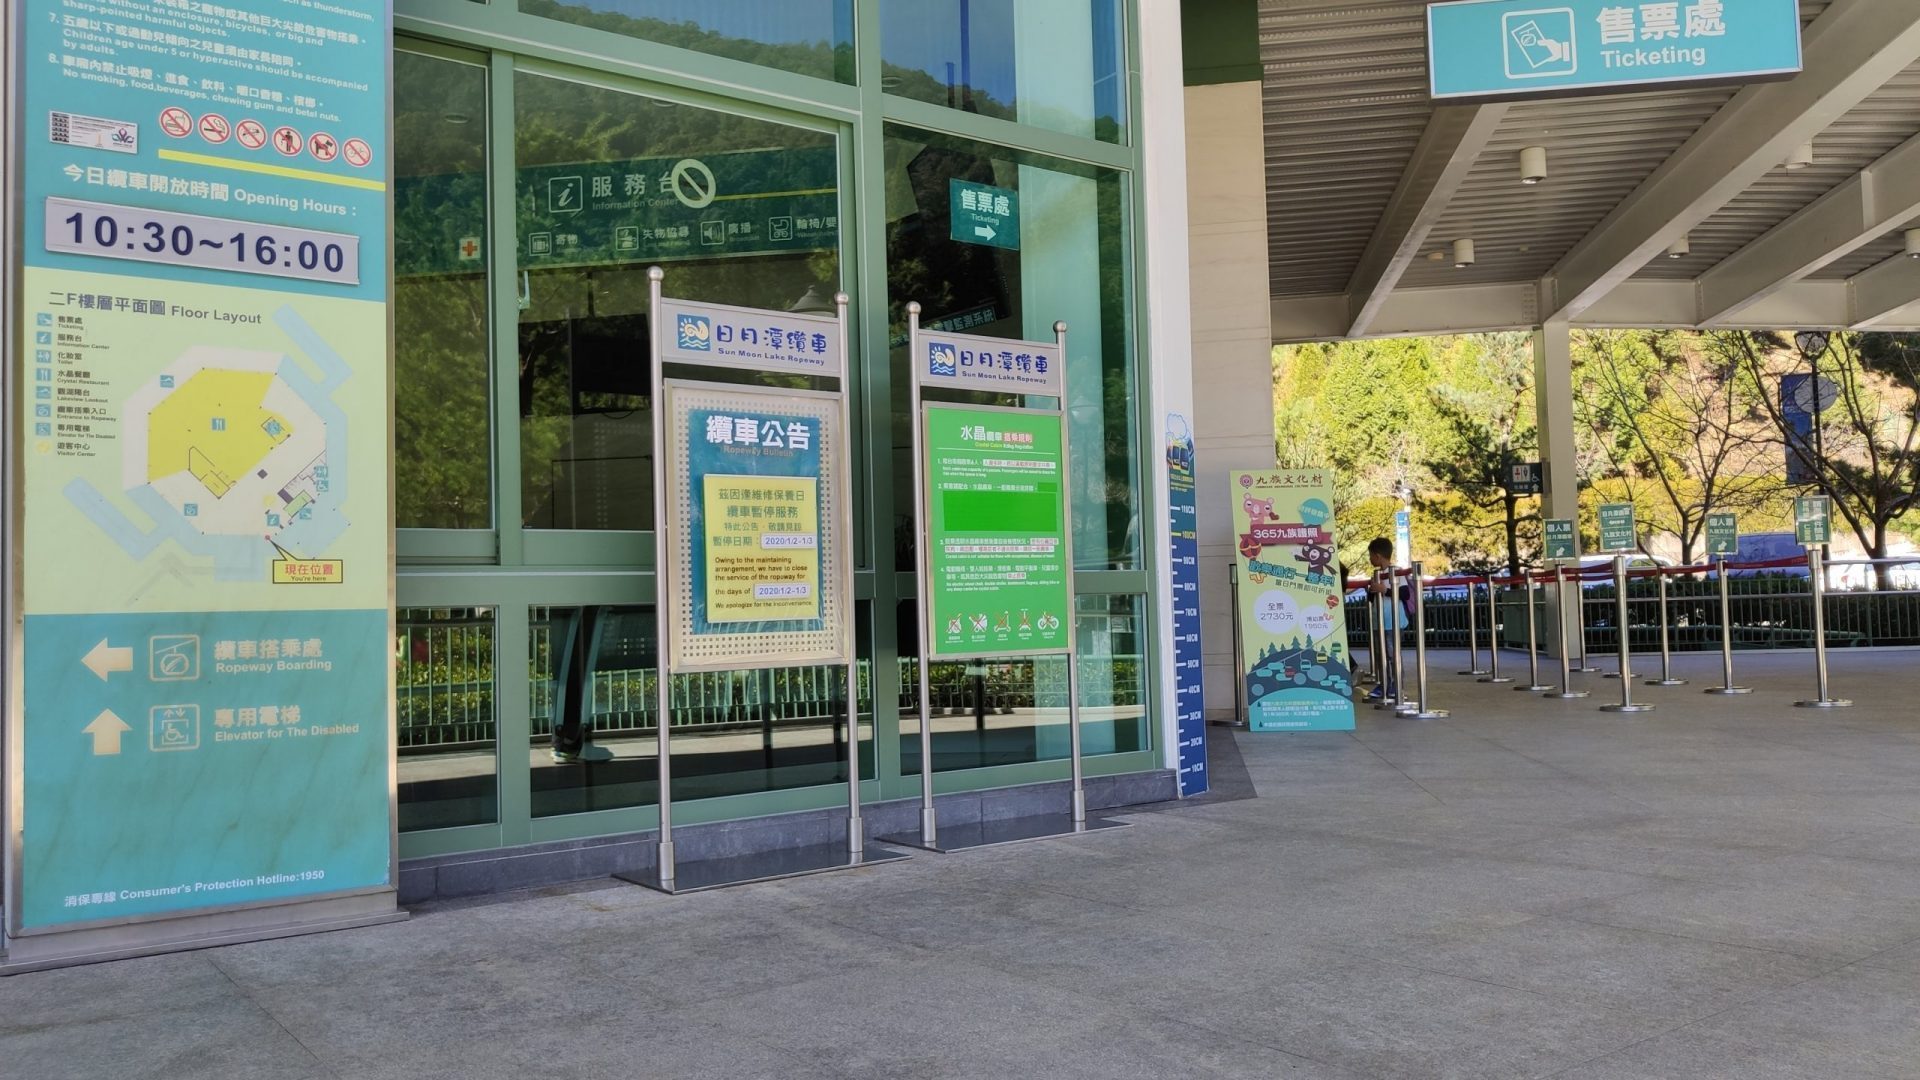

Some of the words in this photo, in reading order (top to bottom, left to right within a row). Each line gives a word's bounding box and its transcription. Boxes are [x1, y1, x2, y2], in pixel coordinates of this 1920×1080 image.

[63, 0, 142, 21] sharp-pointed
[145, 12, 187, 28] harmful
[1596, 1, 1726, 46] 售票處
[152, 5, 166, 14] an
[288, 31, 304, 43] big
[306, 37, 323, 46] and
[63, 39, 79, 50] by
[63, 28, 113, 44] Children
[115, 38, 135, 48] age
[138, 40, 168, 54] under
[171, 47, 177, 55] 5
[180, 50, 190, 58] or
[193, 50, 252, 69] hyperactive
[255, 61, 290, 77] should
[291, 69, 303, 79] be
[306, 73, 368, 91] accompanied
[1600, 45, 1706, 69] Ticketing
[63, 68, 79, 78] No
[81, 71, 129, 87] smoking,
[212, 93, 251, 108] chewing
[254, 102, 274, 111] gum
[276, 105, 294, 114] and
[63, 164, 229, 202] 今日纜車開放時間
[592, 171, 674, 198] 服務台
[234, 188, 299, 211] Opening
[593, 201, 645, 211] Information
[960, 188, 1010, 217] 售票處
[971, 213, 1000, 226] Ticketing
[65, 212, 345, 273] 10:30~16:00
[171, 305, 210, 320] Floor
[213, 308, 262, 325] Layout
[716, 325, 827, 355] 日月潭纜車
[718, 347, 736, 355] Sun
[738, 349, 762, 358] Moon
[764, 352, 785, 361] Lake
[788, 354, 825, 366] Ropeway
[960, 350, 1048, 374] 日月潭纜車
[1017, 375, 1047, 384] Ropeway
[706, 415, 811, 450] 纜車公告
[1255, 474, 1323, 485] 九族文化村
[726, 506, 799, 519] 纜車暫停服務
[1253, 527, 1318, 539] 365九族護照
[285, 563, 334, 575] 現在位置
[715, 557, 735, 565] Owing
[1260, 611, 1294, 621] 2730元
[1267, 602, 1284, 611] 全票
[215, 638, 323, 660] 纜車搭乘處
[215, 662, 273, 673] Ropeway
[277, 660, 332, 672] Boarding
[215, 705, 301, 728] 專用電梯
[215, 729, 265, 742] Elevator
[267, 728, 283, 738] for
[286, 726, 308, 737] The
[311, 723, 360, 736] Disabled
[64, 892, 117, 907] 消保專線
[120, 883, 192, 900] Consumer's
[195, 878, 254, 892] Protection
[257, 870, 325, 885] Hotline:1950
